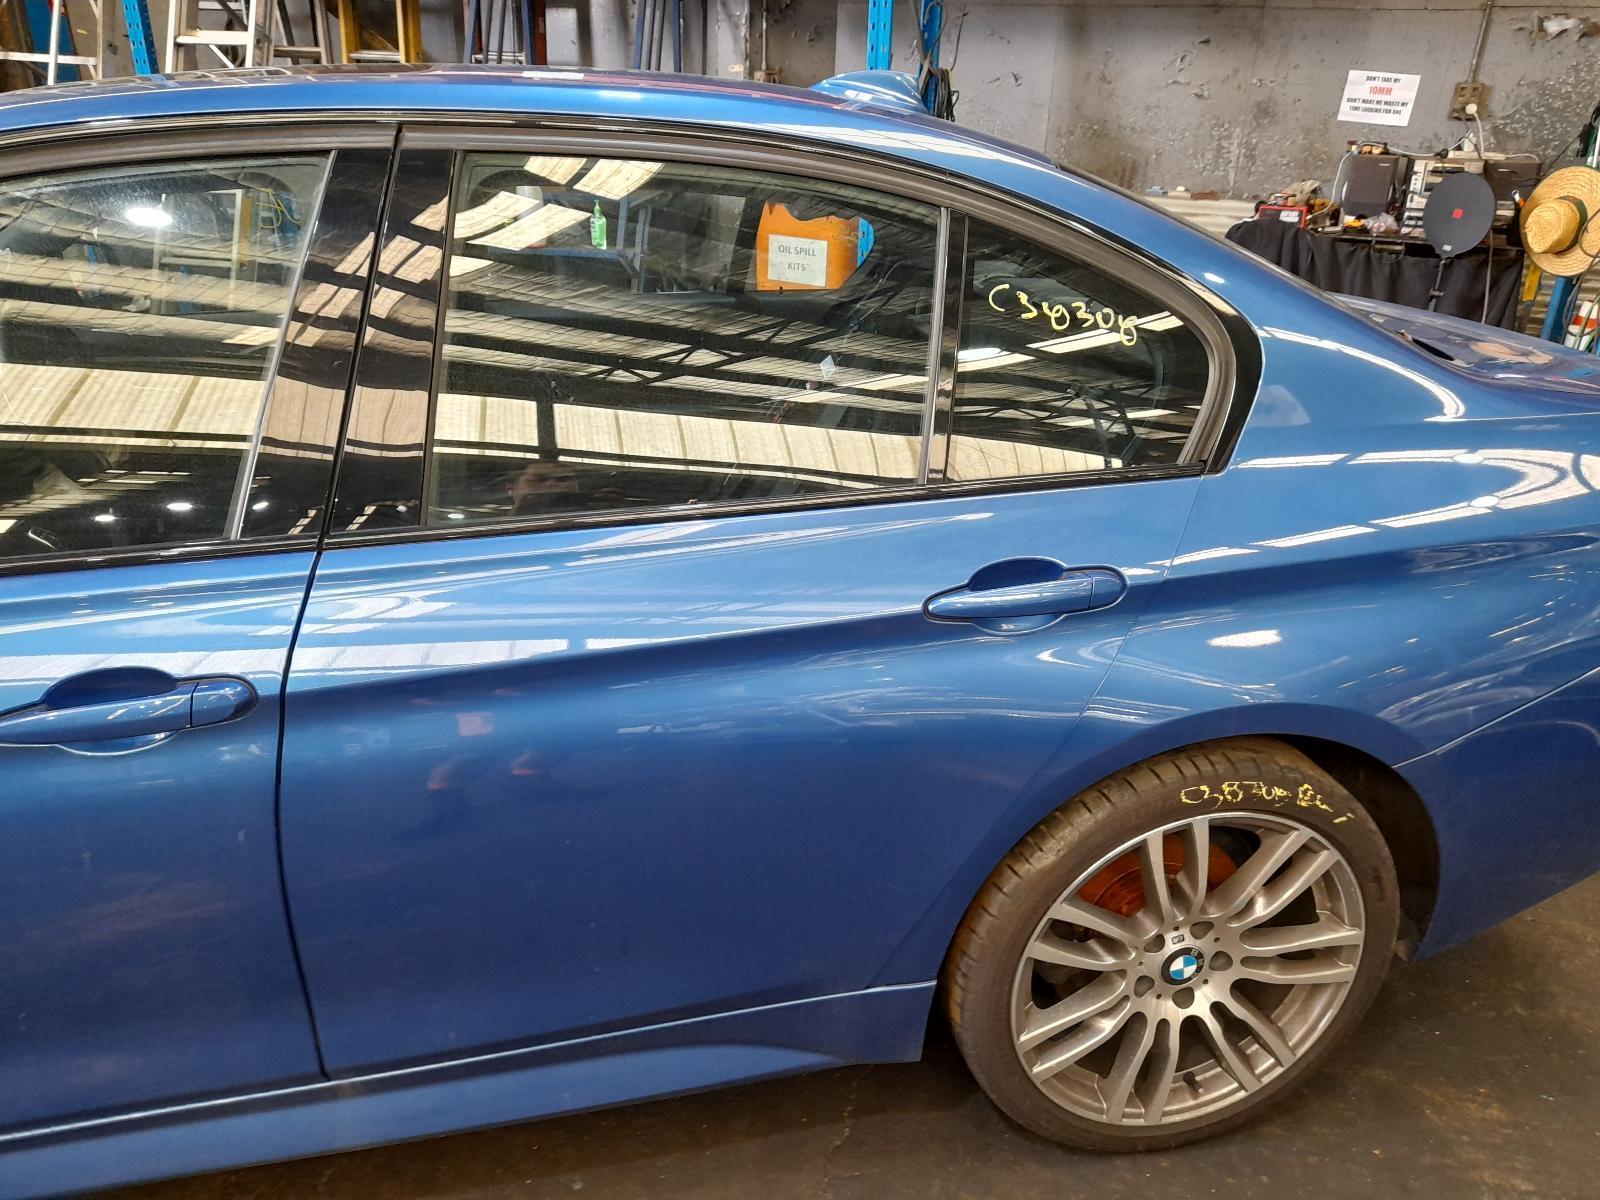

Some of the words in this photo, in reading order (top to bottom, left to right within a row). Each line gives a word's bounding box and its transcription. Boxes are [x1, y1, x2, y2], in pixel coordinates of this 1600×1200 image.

[1369, 86, 1392, 96] 10MM
[778, 244, 792, 255] OIL
[794, 247, 817, 257] SPILL
[787, 262, 806, 272] KITS
